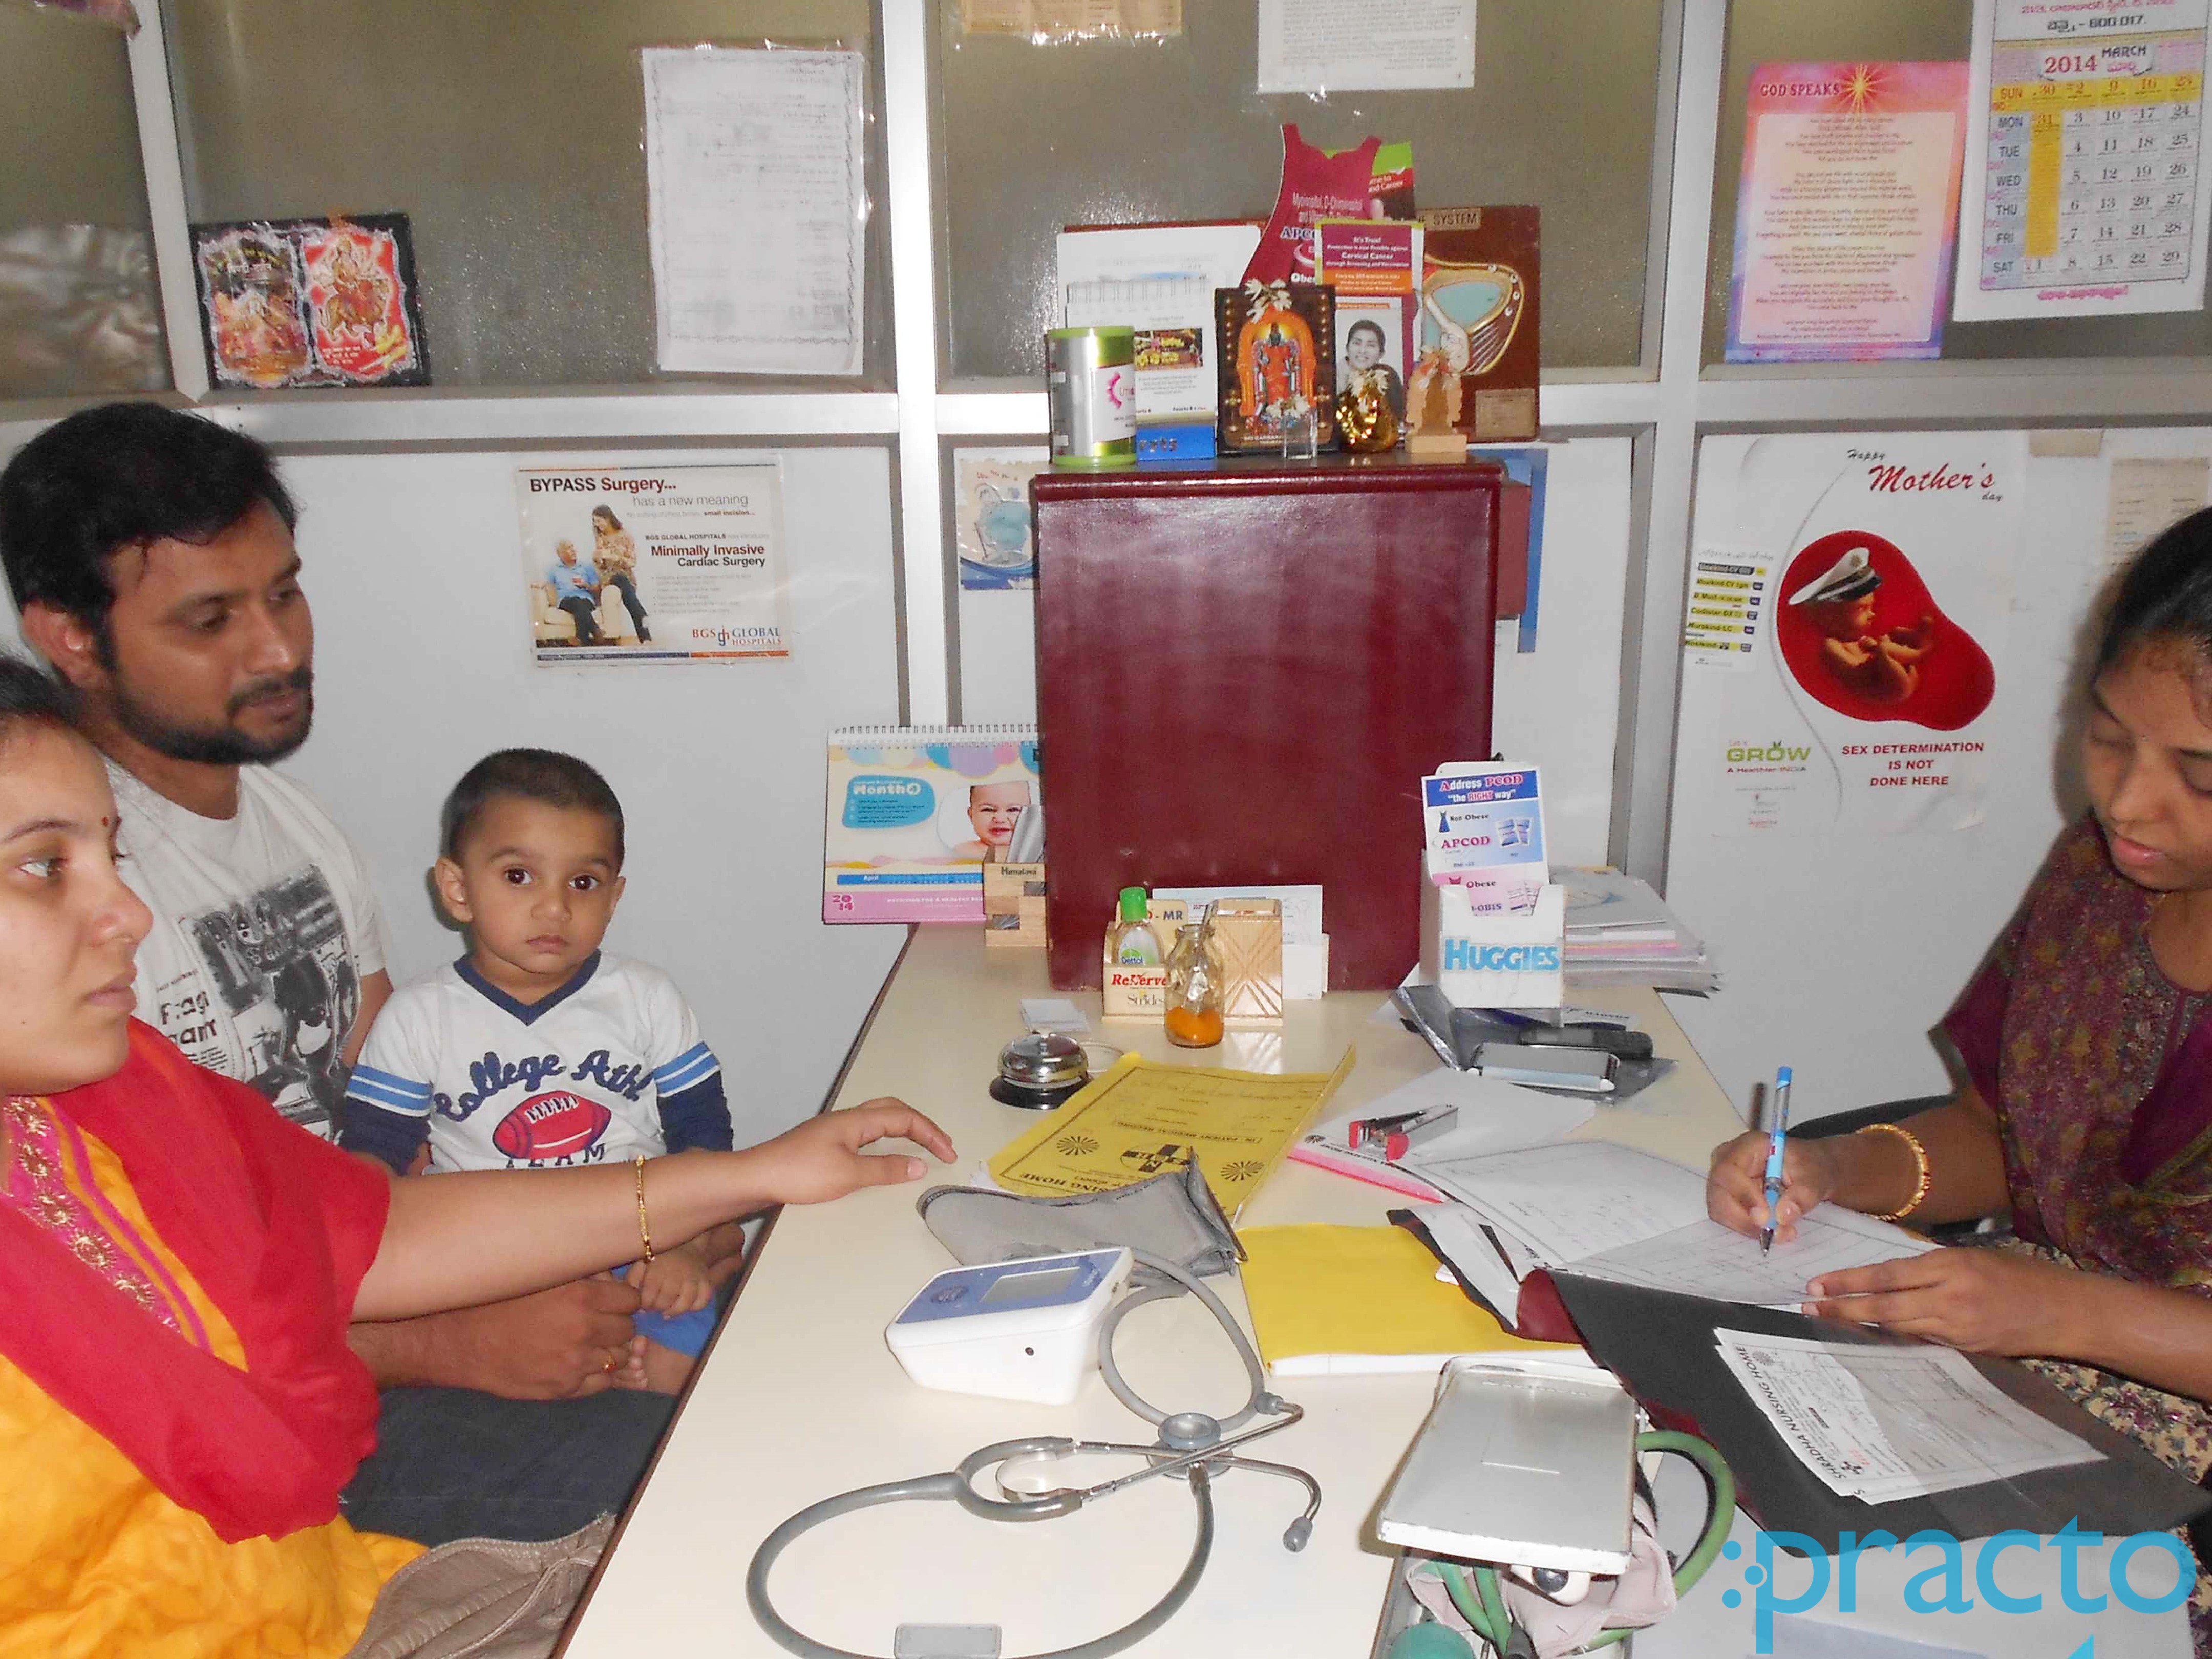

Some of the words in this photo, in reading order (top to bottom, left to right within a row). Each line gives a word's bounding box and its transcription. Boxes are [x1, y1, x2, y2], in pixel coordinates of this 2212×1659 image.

[2044, 55, 2097, 73] 2014
[2101, 45, 2147, 58] MARCH
[1760, 83, 1786, 97] GOD
[1791, 83, 1840, 96] SPEAKS
[2001, 87, 2023, 100] SUN
[2076, 82, 2085, 94] 2
[2109, 80, 2119, 93] 9
[2141, 77, 2157, 89] 16
[2174, 75, 2193, 87] 23
[1998, 116, 2023, 129] MON
[2037, 113, 2053, 124] 31
[2074, 112, 2083, 123] 3
[2105, 110, 2120, 121] 10
[2139, 108, 2154, 119] 17
[2173, 104, 2190, 117] 24
[1999, 146, 2020, 158] TUE
[2074, 141, 2081, 153] 4
[2104, 139, 2118, 150] 11
[2137, 137, 2154, 148] 18
[2171, 134, 2189, 146] 25
[1996, 175, 2022, 187] WED
[2073, 170, 2081, 182] 5
[2102, 167, 2118, 180] 12
[2136, 165, 2151, 178] 19
[2168, 163, 2187, 175] 26
[1996, 204, 2017, 216] THU
[2070, 200, 2079, 210] 6
[2100, 197, 2115, 209] 13
[2132, 195, 2150, 206] 20
[2166, 192, 2184, 205] 27
[1996, 232, 2015, 244] FRI
[2070, 228, 2078, 240] 7
[2099, 226, 2113, 238] 14
[2131, 224, 2146, 236] 21
[2164, 222, 2182, 234] 28
[1993, 261, 2015, 273] SAT
[2035, 260, 2041, 270] 1
[2068, 257, 2076, 267] 8
[2098, 254, 2114, 266] 15
[2129, 252, 2146, 264] 22
[2162, 250, 2180, 262] 29
[1847, 449, 1886, 461] Happy
[1868, 462, 1995, 493] Mother's
[530, 477, 597, 493] BYPASS
[601, 477, 677, 494] Surgery...
[632, 495, 654, 507] has
[658, 498, 666, 507] a
[669, 497, 692, 506] new
[696, 494, 749, 507] meaning
[1981, 492, 2003, 502] day
[651, 545, 710, 557] Minimally
[714, 544, 765, 556] Invasive
[677, 557, 719, 567] Cardiac
[722, 556, 765, 567] Surgery
[692, 628, 716, 639] BGS
[732, 627, 780, 638] GLOBAL
[1727, 743, 1811, 762] GROW
[1842, 745, 1868, 755] SEX
[1873, 742, 1985, 754] DETERMINATION
[1888, 760, 1901, 770] IS
[1906, 759, 1935, 770] NOT
[1439, 779, 1482, 792] Address
[1485, 773, 1524, 787] PCOD
[1870, 776, 1908, 787] DONE
[1911, 776, 1949, 786] HERE
[853, 784, 906, 795] Month
[1467, 791, 1494, 802] RIGHT
[1441, 836, 1491, 849] APCOD
[1466, 880, 1496, 888] Obese
[832, 895, 853, 903] 20
[839, 902, 854, 911] 14
[1163, 910, 1183, 920] MR
[1121, 956, 1143, 965] Dettol
[1444, 939, 1561, 971] HUGGIES
[1127, 994, 1165, 1006] Strides
[434, 1051, 566, 1122] College
[1022, 1173, 1066, 1186] HOME
[1735, 1345, 1763, 1379] HOME
[1758, 1382, 1800, 1432] NURSING
[1797, 1434, 1847, 1480] SHRADHA
